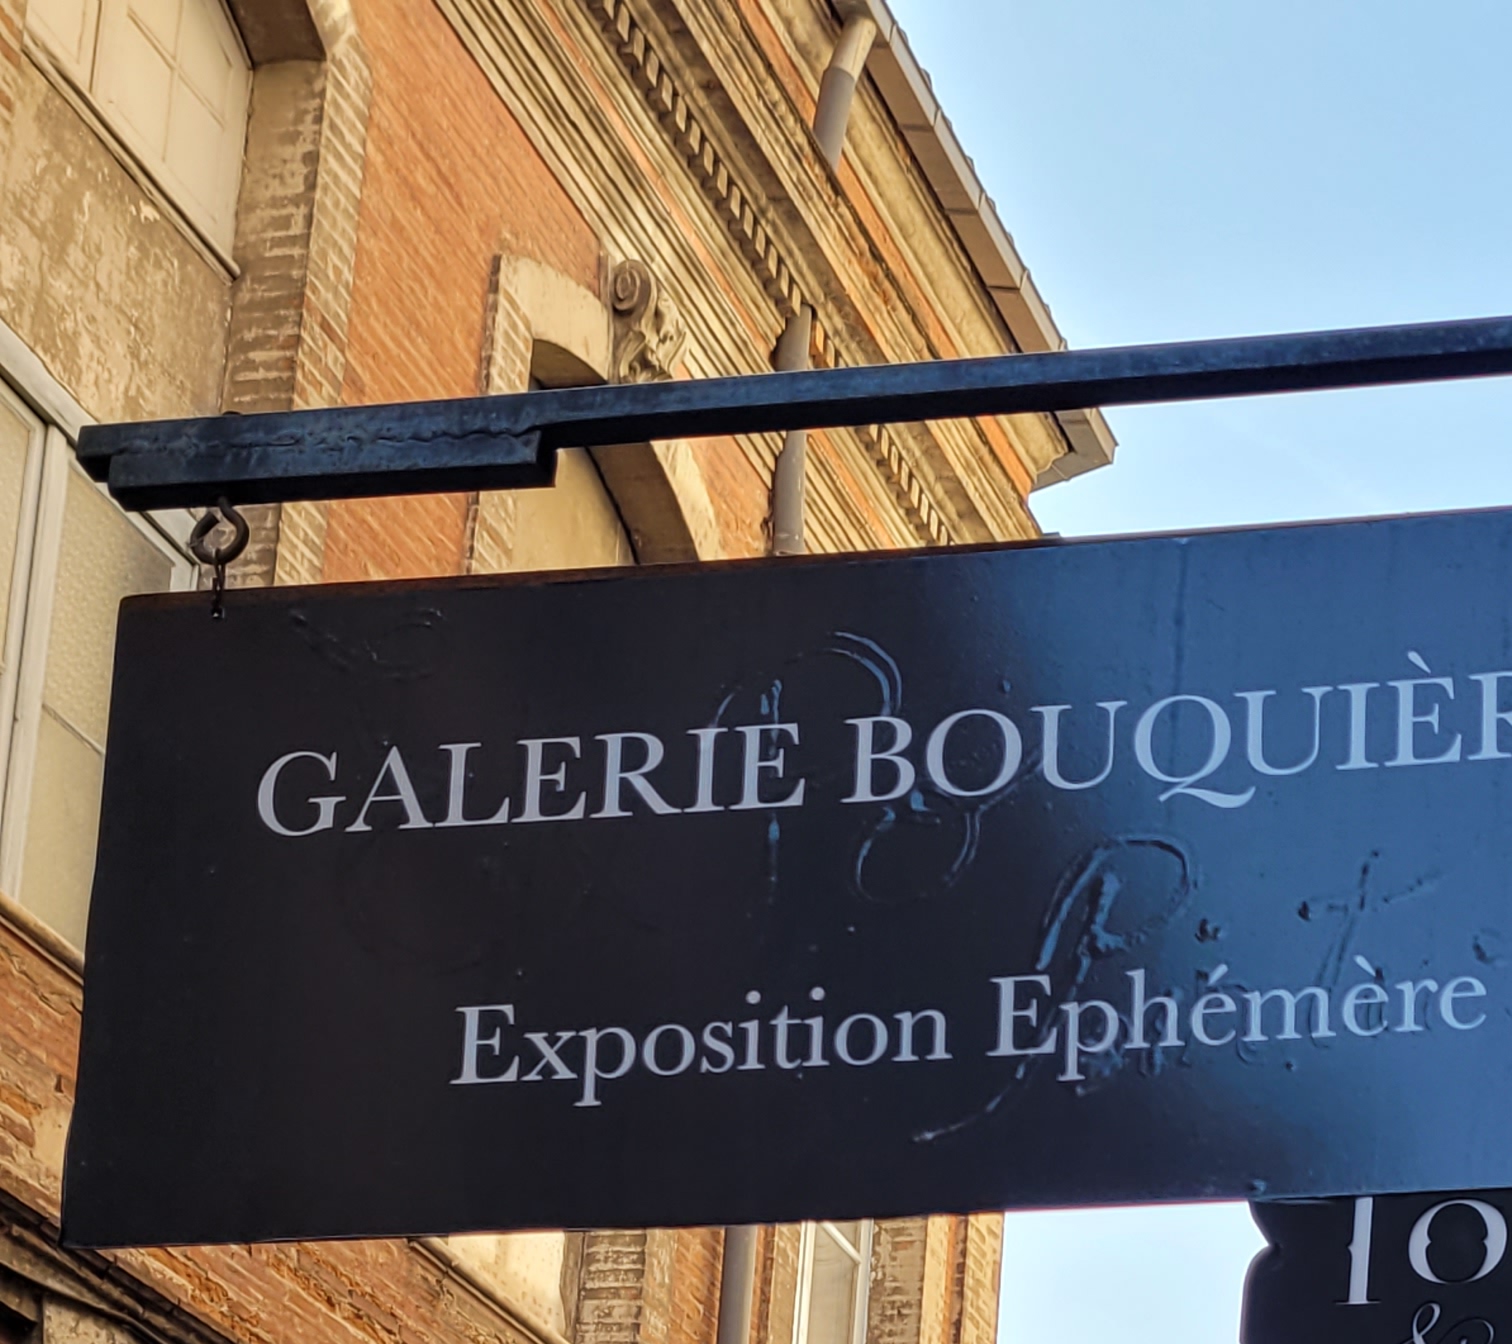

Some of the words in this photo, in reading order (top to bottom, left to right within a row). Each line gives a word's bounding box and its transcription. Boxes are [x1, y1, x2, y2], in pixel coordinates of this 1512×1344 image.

[257, 722, 807, 838] GALERIE
[449, 985, 954, 1108] Exposition
[985, 964, 1488, 1083] Ephémère
